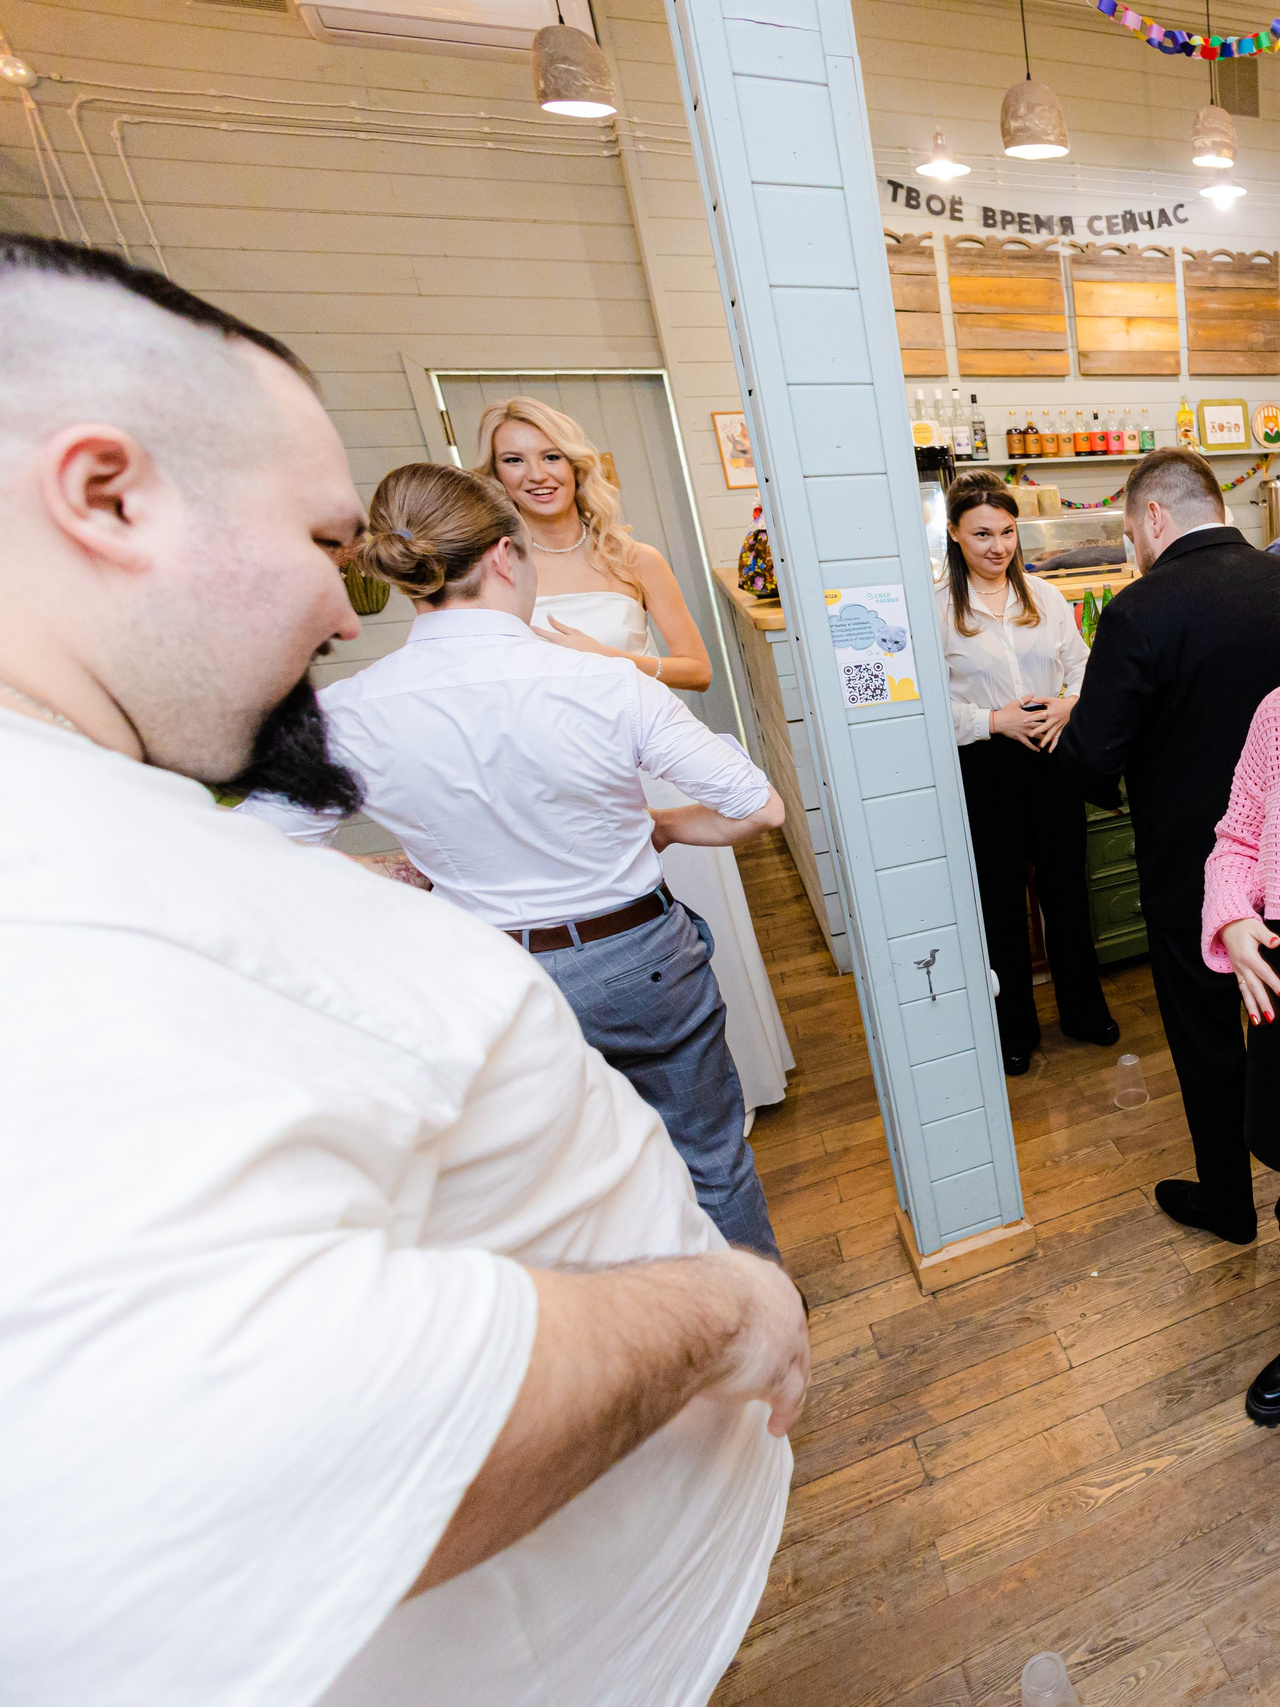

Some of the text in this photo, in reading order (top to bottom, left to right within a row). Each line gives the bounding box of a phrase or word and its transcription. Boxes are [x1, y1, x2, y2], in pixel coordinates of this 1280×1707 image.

[887, 180, 1189, 236] ТВОЁ ВРЕМЯ СЕЙЧАС
